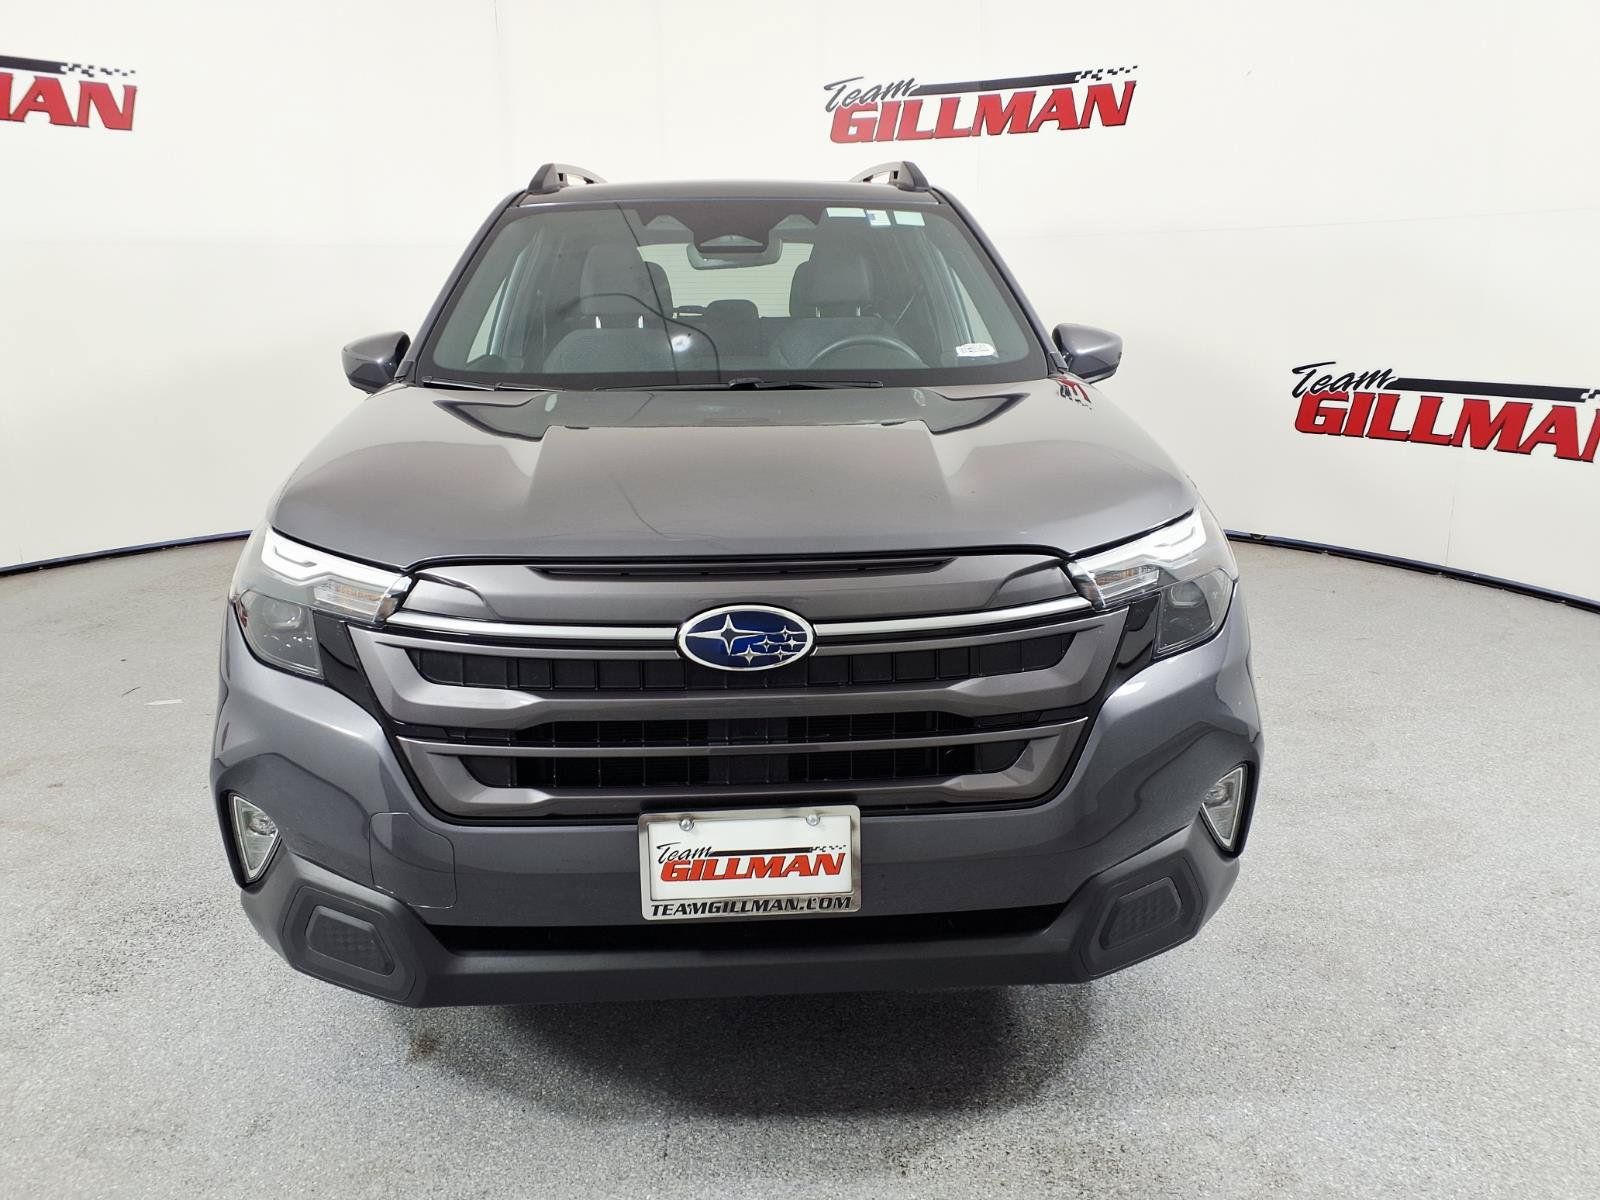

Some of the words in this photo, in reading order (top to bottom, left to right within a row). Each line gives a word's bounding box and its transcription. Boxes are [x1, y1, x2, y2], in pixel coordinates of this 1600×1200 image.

[0, 71, 137, 131] AN
[824, 76, 917, 112] Team
[830, 81, 1136, 143] GILLMAN
[1292, 361, 1395, 398] Team
[656, 841, 712, 864] Team
[661, 852, 845, 881] GILLMAN
[652, 896, 851, 916] TEAMGILLMAN.COM
